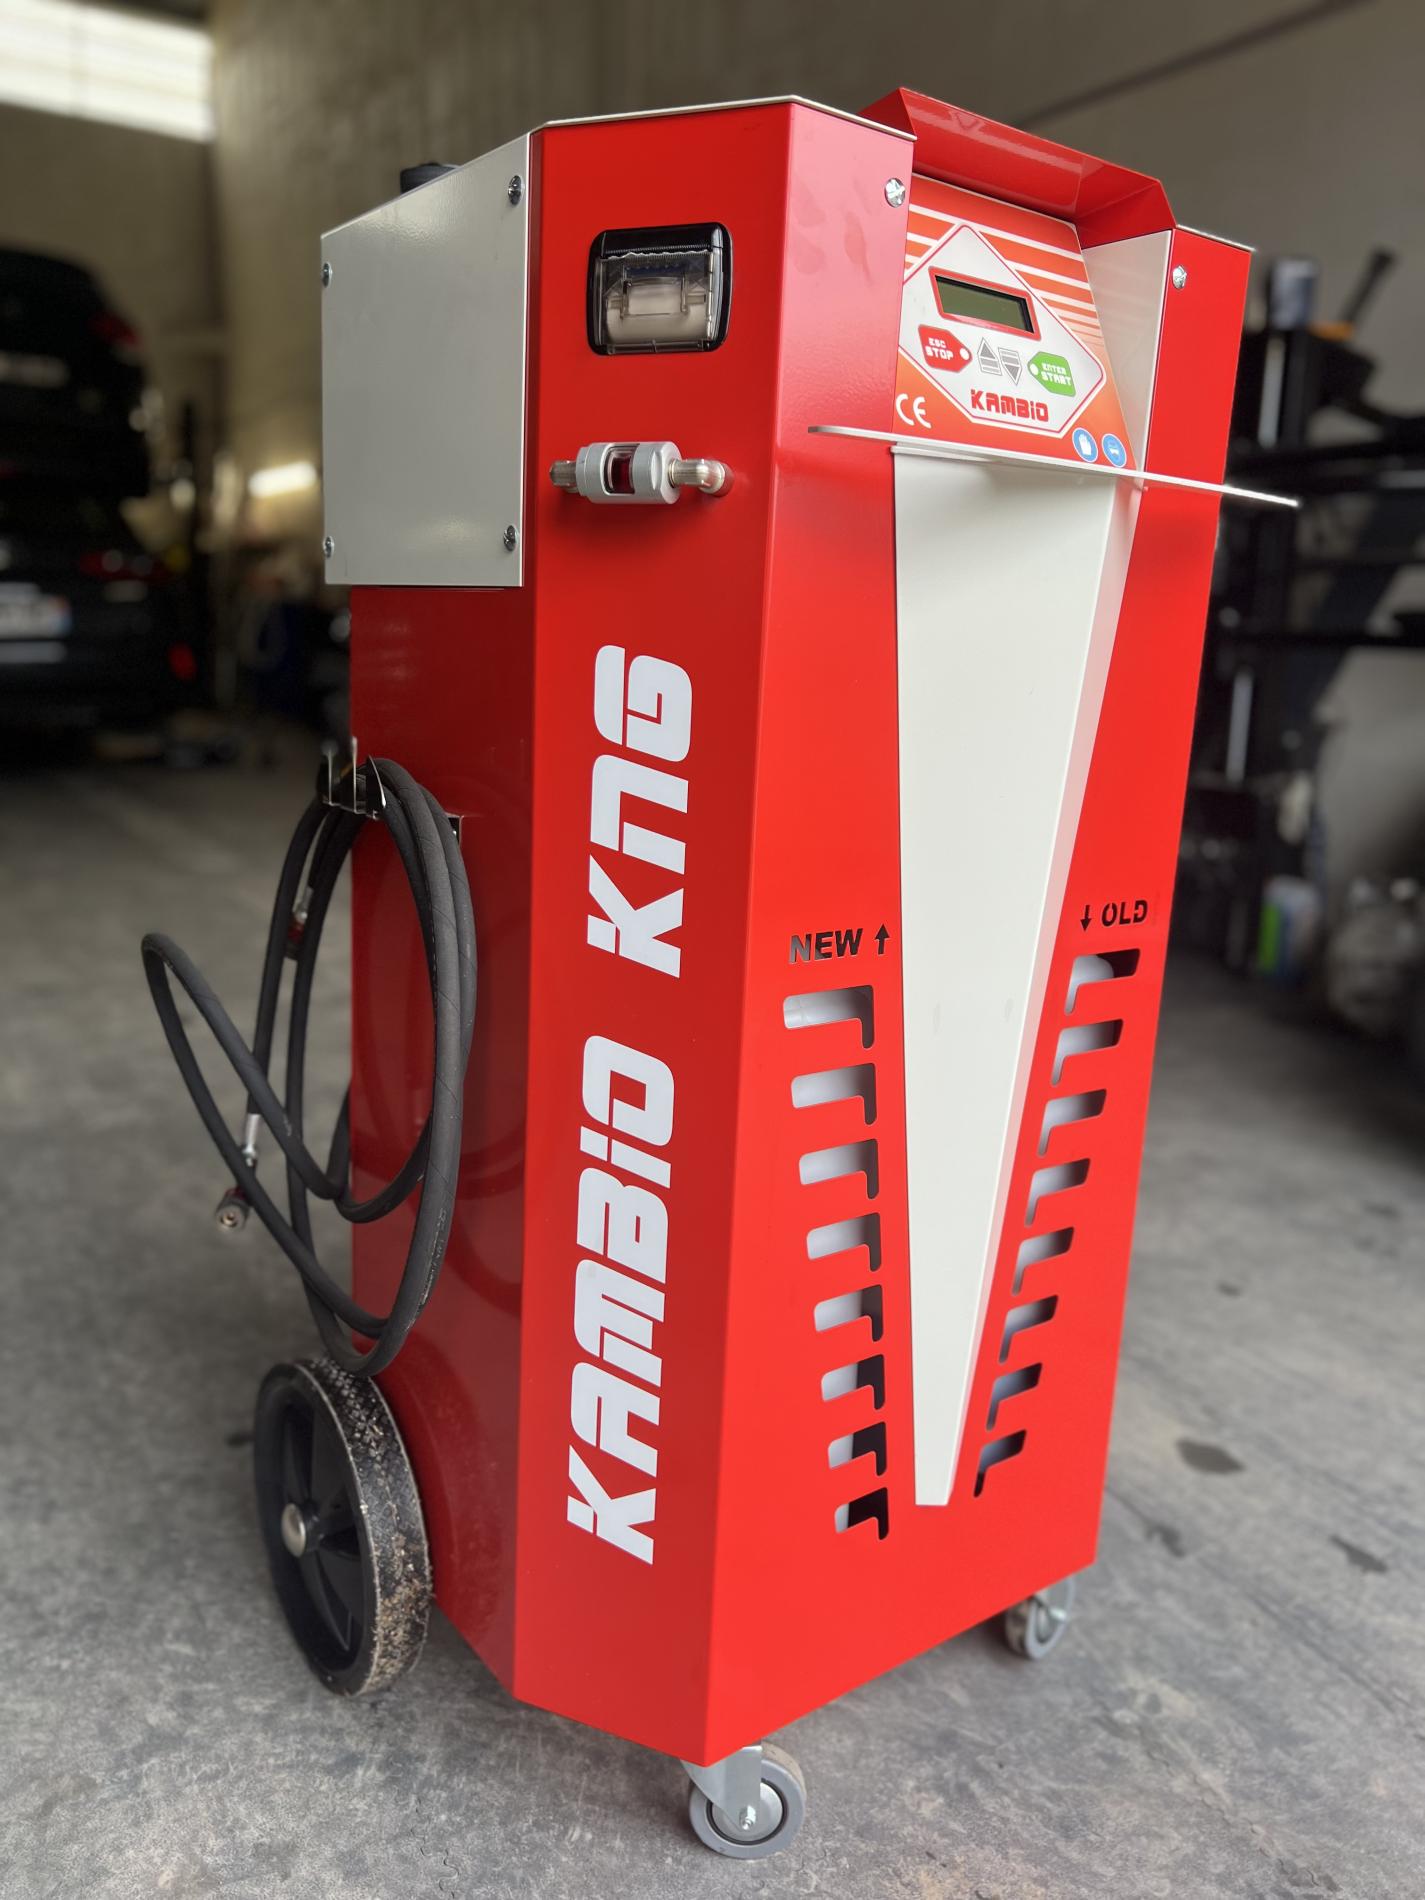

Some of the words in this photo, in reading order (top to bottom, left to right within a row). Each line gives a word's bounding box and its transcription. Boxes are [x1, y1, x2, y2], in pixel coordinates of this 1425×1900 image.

[925, 346, 954, 360] STOP
[1041, 372, 1072, 387] START
[1101, 899, 1149, 928] OLD
[789, 928, 863, 964] NEW
